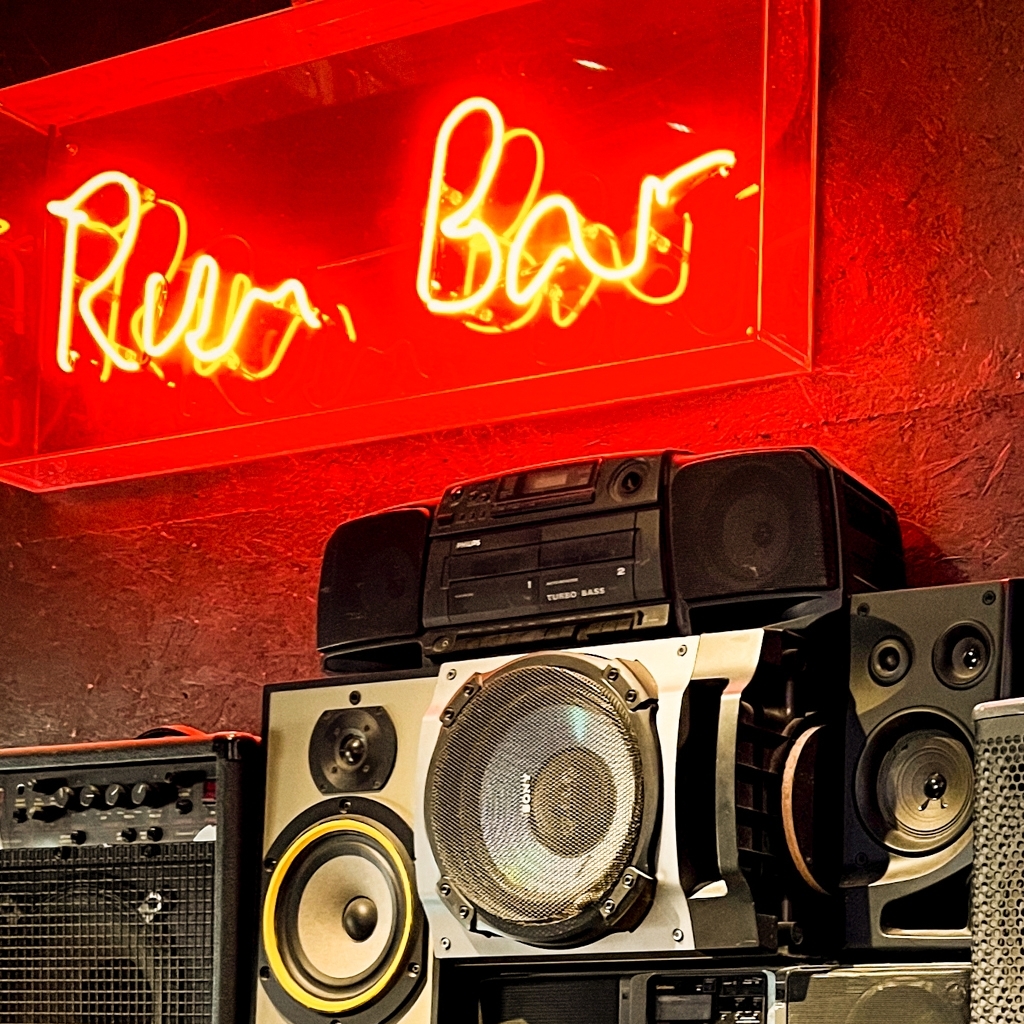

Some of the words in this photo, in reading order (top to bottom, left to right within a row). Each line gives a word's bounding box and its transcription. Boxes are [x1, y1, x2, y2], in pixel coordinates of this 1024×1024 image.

[46, 170, 322, 373] Rum
[415, 95, 737, 314] Bar
[546, 591, 577, 601] TURBO
[581, 587, 605, 597] BASS
